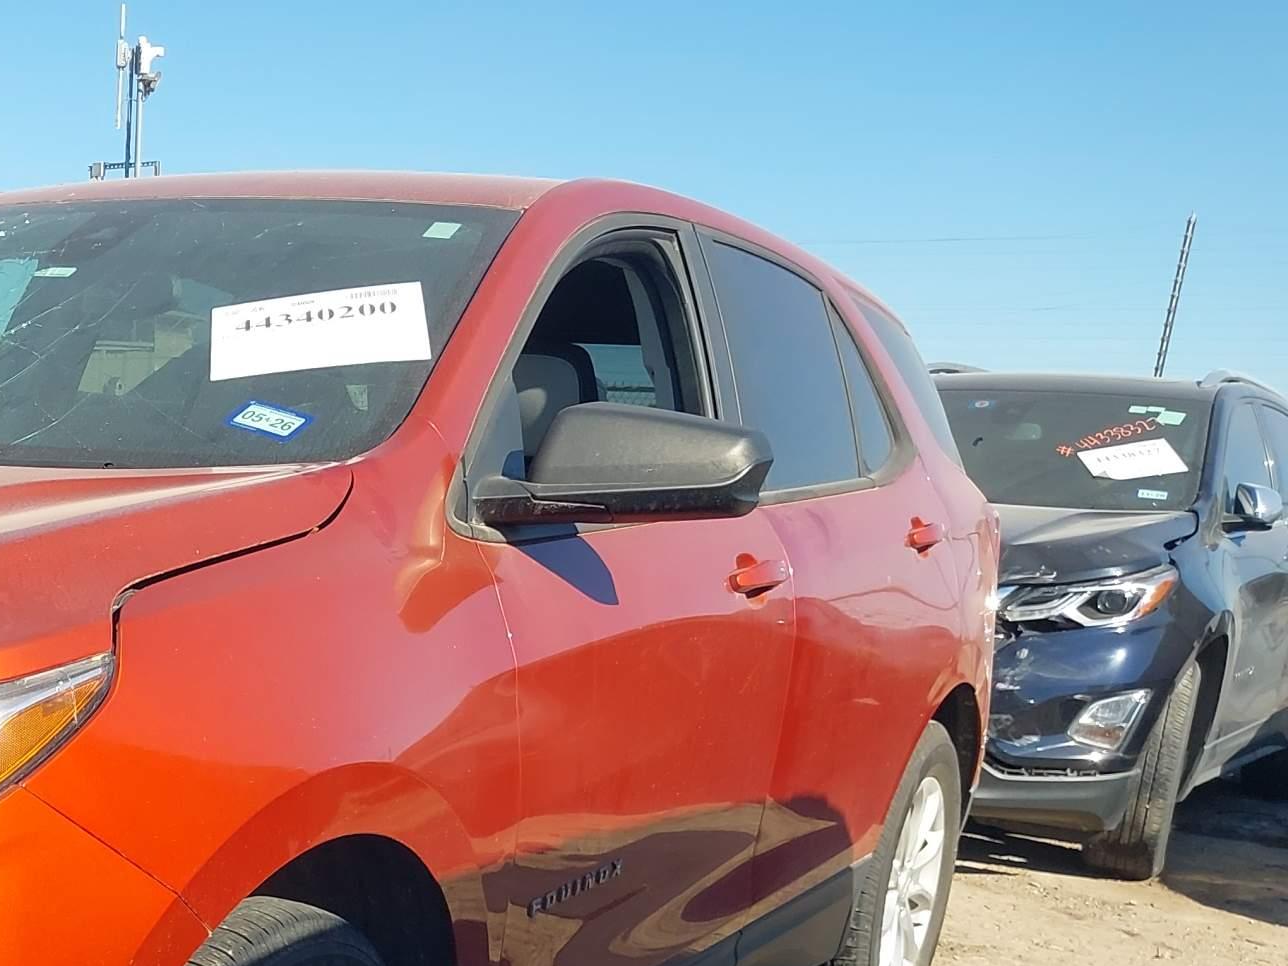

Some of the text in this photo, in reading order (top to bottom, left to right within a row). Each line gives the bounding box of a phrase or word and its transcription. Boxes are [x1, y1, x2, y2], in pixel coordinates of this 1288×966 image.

[235, 301, 397, 332] 44340200
[241, 410, 295, 431] 05 26
[527, 858, 623, 918] EQUINOX
